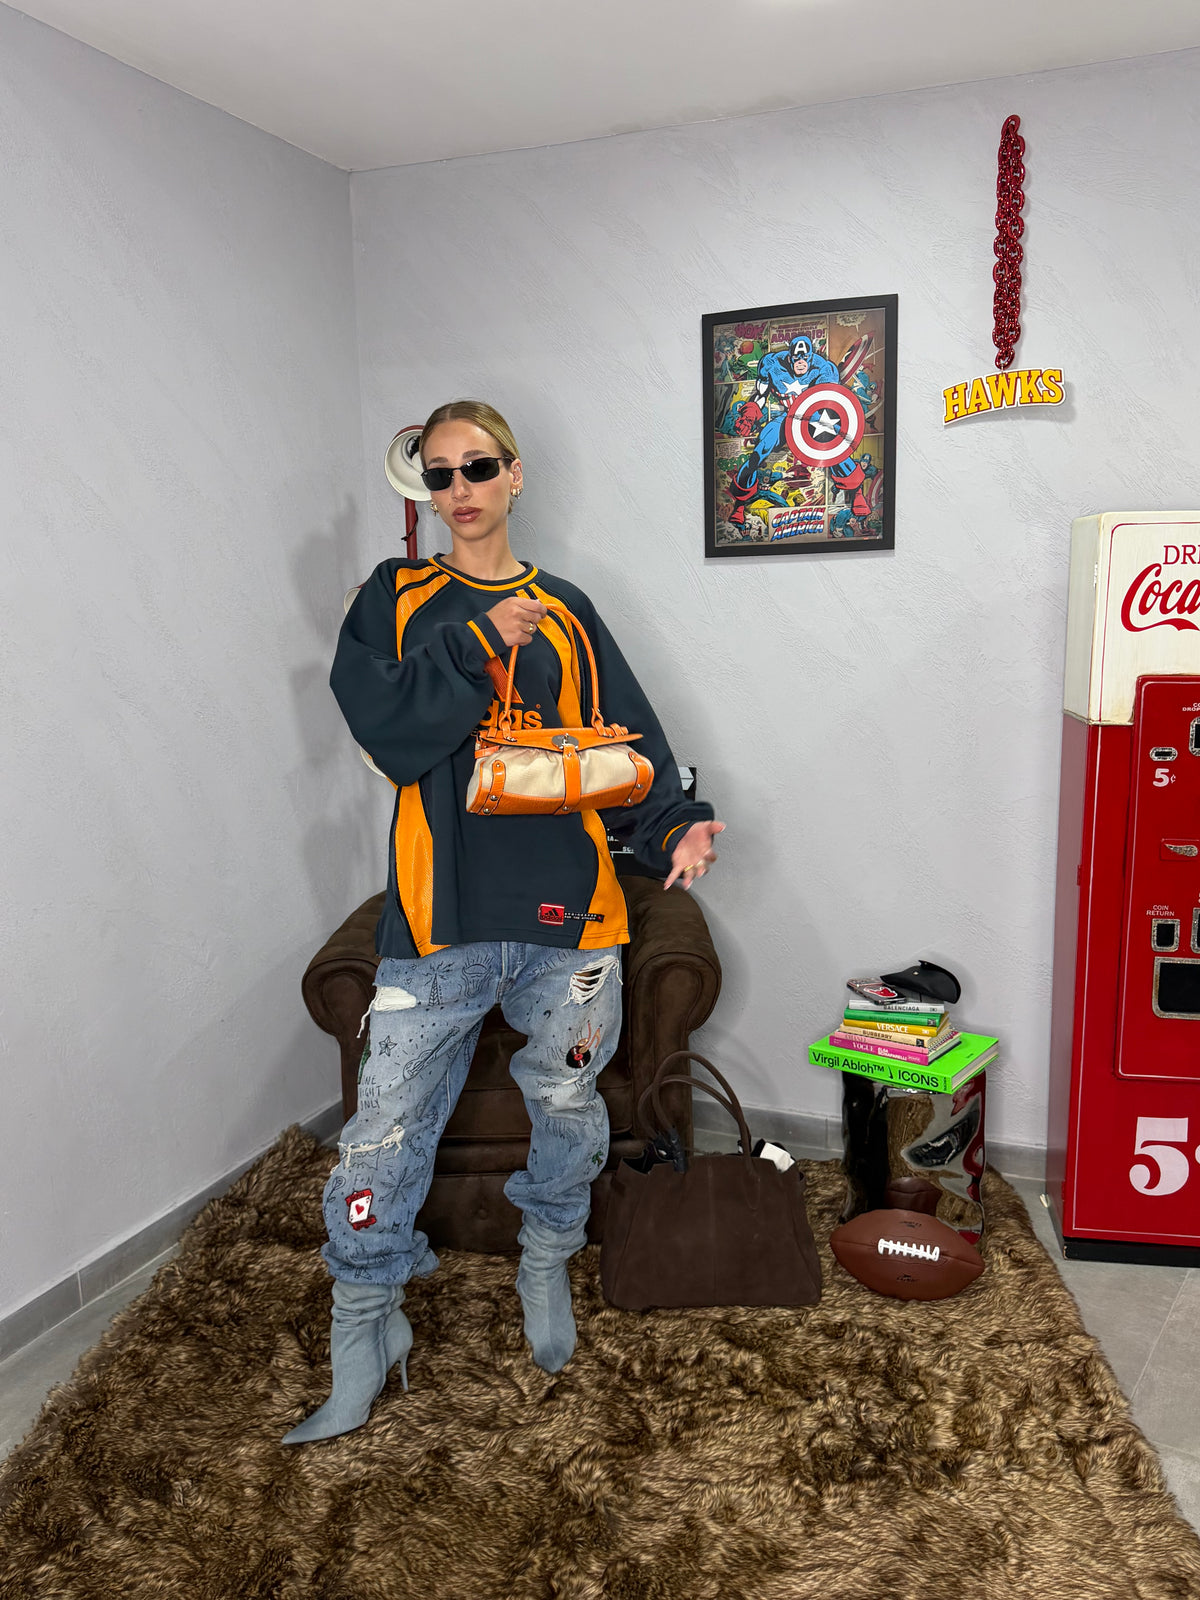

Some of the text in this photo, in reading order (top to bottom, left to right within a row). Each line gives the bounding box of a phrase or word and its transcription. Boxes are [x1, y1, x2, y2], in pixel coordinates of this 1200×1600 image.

[943, 368, 1065, 424] HAWKS
[772, 507, 826, 528] CAPTAIN
[770, 520, 825, 542] AMERICA
[1152, 767, 1177, 788] 5¢
[862, 1029, 893, 1040] BURBERRY
[876, 1022, 909, 1034] VERSACE
[852, 1041, 874, 1052] VOGUE
[812, 1051, 840, 1068] Virgil
[842, 1057, 885, 1074] Abloh™
[898, 1069, 939, 1088] ICONS
